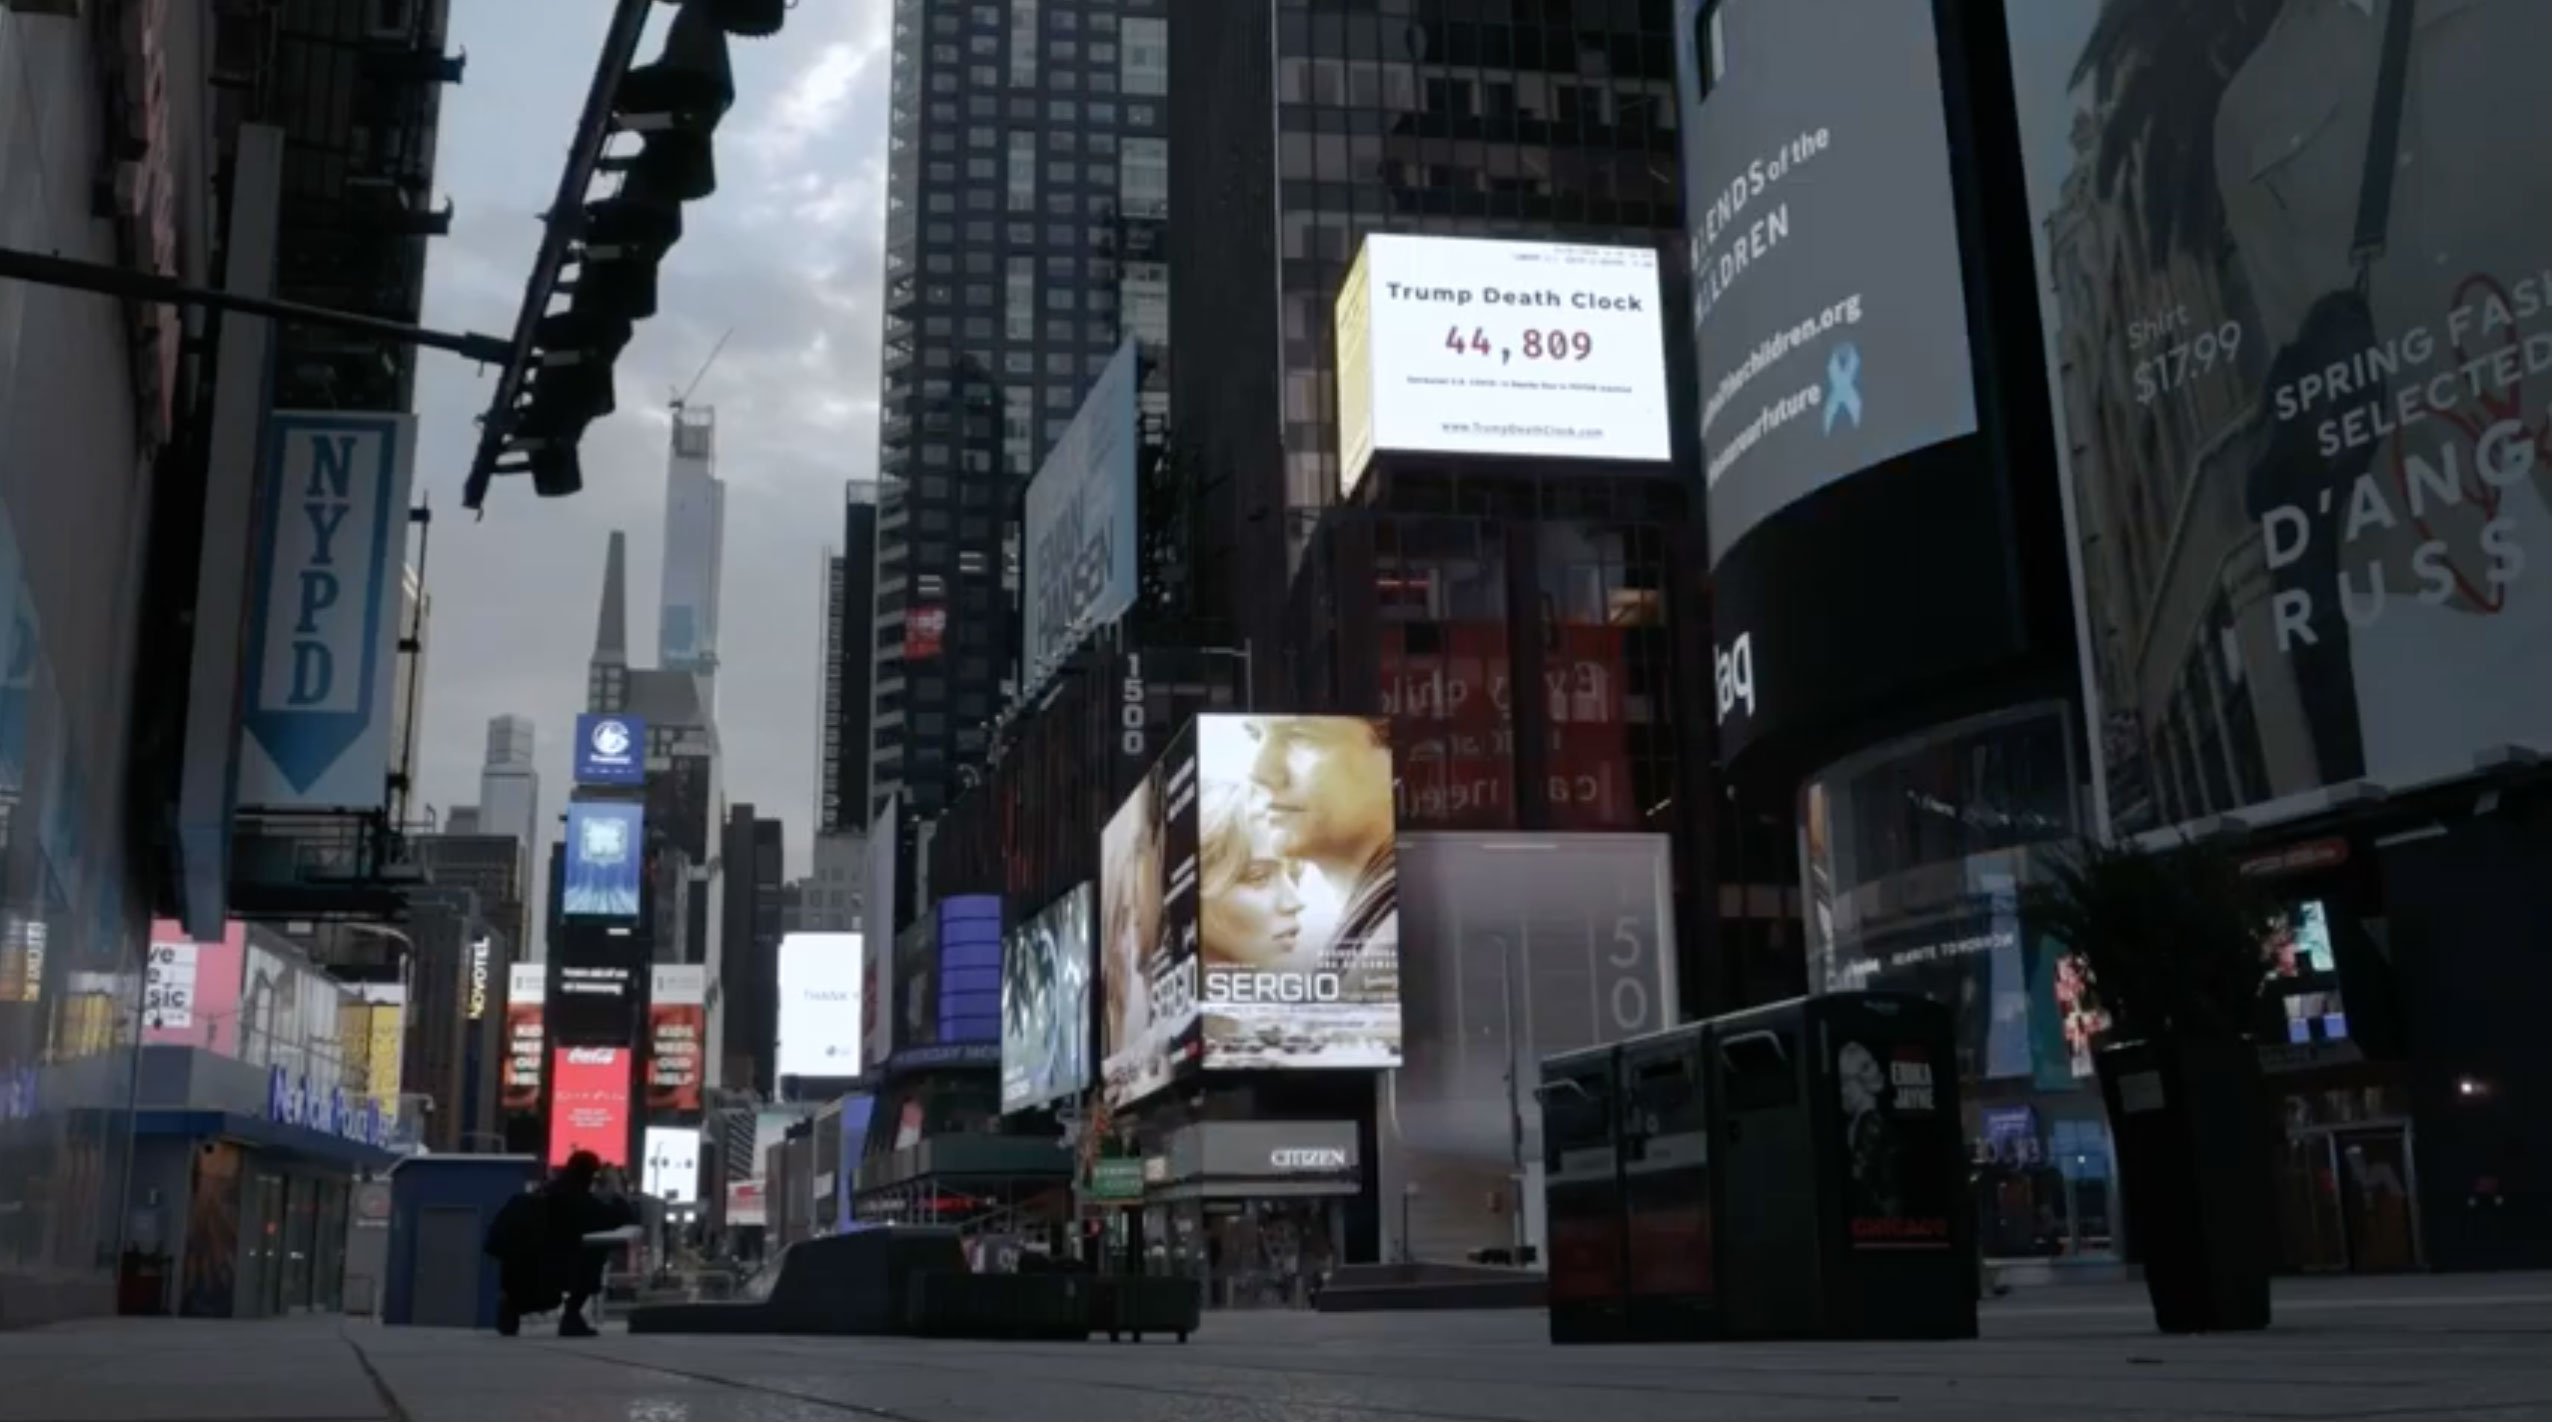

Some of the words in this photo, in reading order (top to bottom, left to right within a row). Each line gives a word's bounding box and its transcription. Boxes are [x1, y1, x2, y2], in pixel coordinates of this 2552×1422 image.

[1791, 127, 1830, 164] the
[1386, 281, 1473, 305] Trump
[1483, 287, 1562, 308] Death
[1571, 292, 1644, 312] Clock
[2128, 304, 2191, 349] Shirt
[1444, 325, 1593, 366] 44,809
[2134, 320, 2242, 405] $17.99
[2273, 325, 2435, 421] SPRING
[2317, 332, 2552, 457] SELECTED
[287, 435, 358, 706] NYPD
[2272, 515, 2527, 653] RUSS
[1121, 652, 1146, 756] 1500
[468, 936, 490, 1019] NOVOTEL
[1206, 972, 1340, 1002] SERGIO
[1270, 1147, 1347, 1168] CITIZEN
